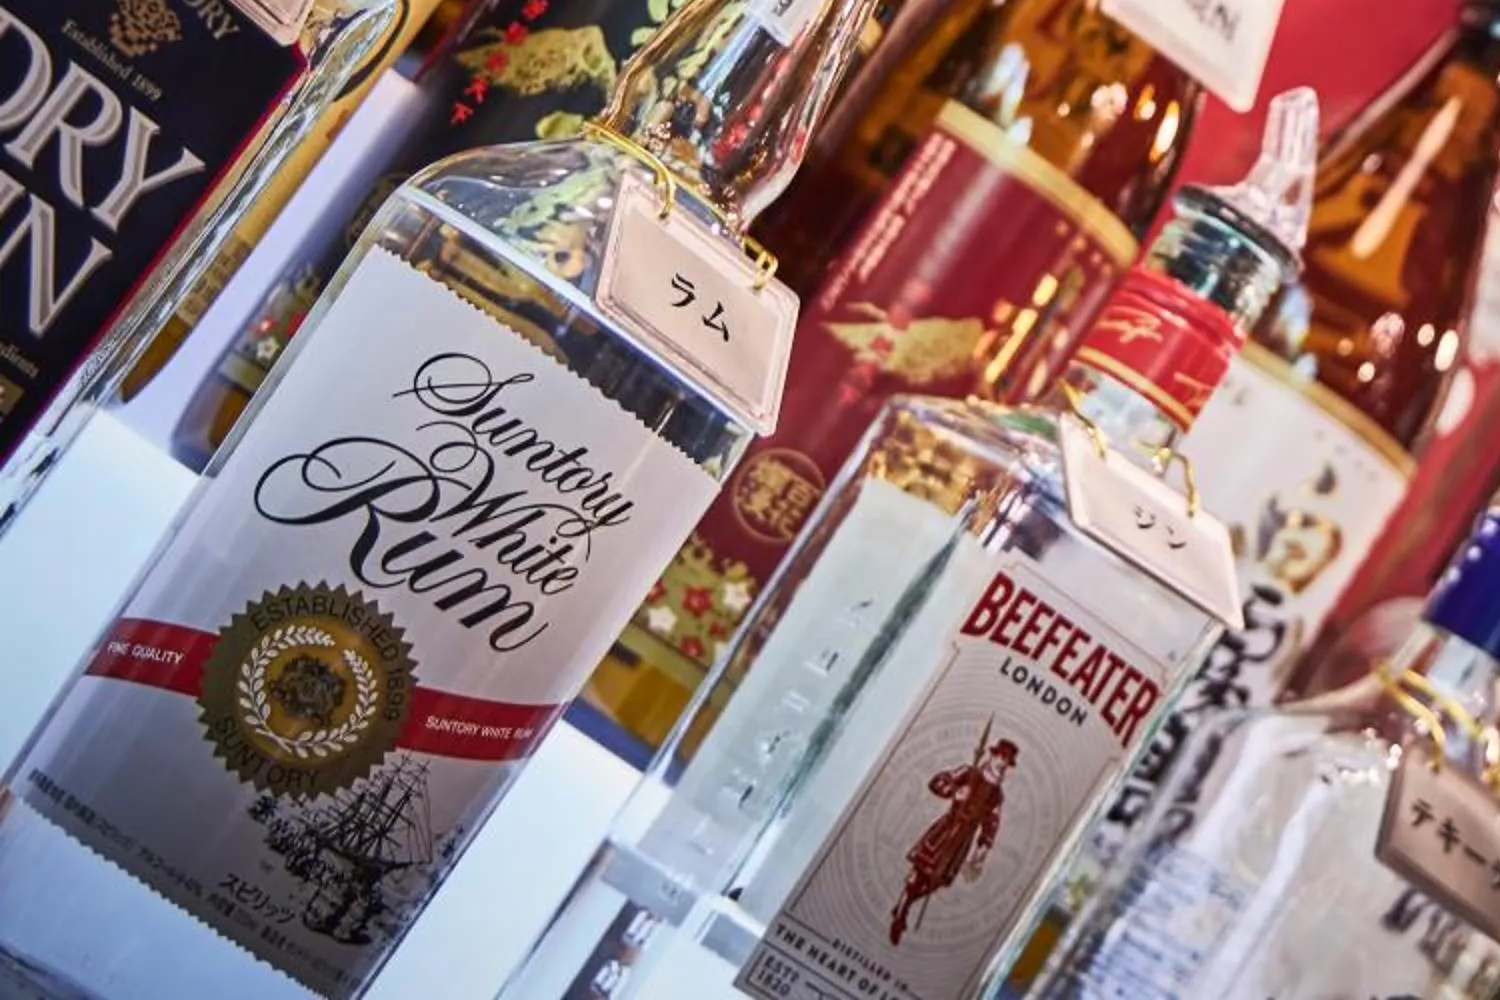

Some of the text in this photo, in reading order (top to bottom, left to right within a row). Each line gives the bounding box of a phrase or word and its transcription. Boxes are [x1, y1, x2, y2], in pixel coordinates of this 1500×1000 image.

[60, 18, 134, 83] Established
[0, 5, 206, 232] DRY
[669, 272, 731, 341] ラム
[392, 353, 635, 538] Suntory
[416, 421, 592, 596] White
[254, 437, 550, 653] Rum
[131, 644, 185, 665] QUALITY
[249, 593, 398, 661] ESTABLISHED
[959, 571, 1163, 750] BEEFEATER
[424, 714, 481, 738] SUNTORY
[480, 722, 513, 741] WHITE
[999, 656, 1089, 728] LONDON
[215, 717, 320, 790] SUNTORY
[216, 873, 296, 925] スピリッツ
[775, 923, 803, 951] THE
[807, 945, 855, 984] HEART
[857, 974, 880, 997] OF
